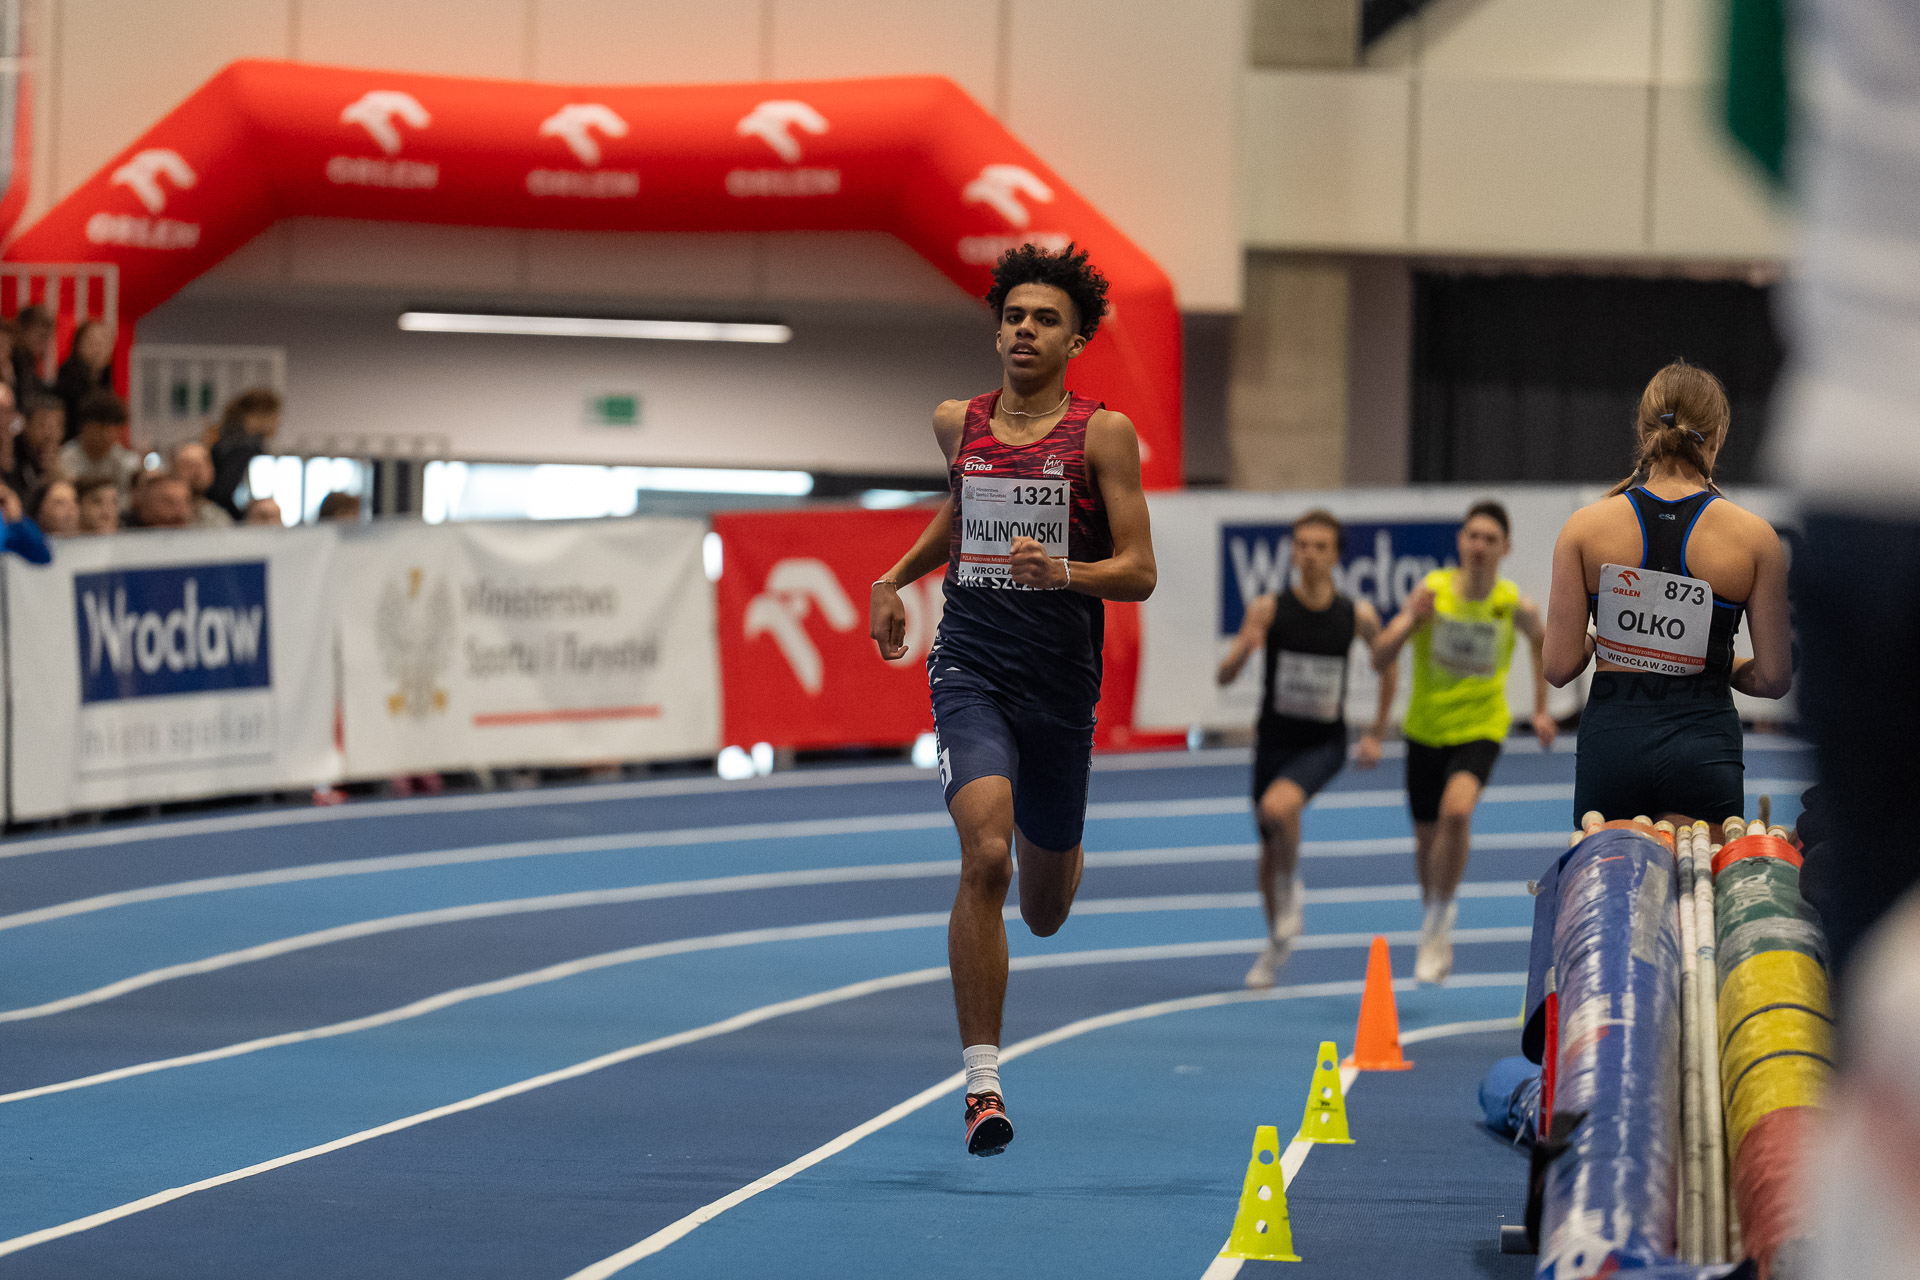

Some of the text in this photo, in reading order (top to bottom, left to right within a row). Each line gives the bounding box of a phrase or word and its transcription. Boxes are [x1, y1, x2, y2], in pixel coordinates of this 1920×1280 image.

[964, 461, 993, 471] Enea
[1012, 485, 1066, 506] 1321
[966, 519, 1062, 543] MALINOWSKI
[1612, 581, 1705, 606] ORLEN 873
[1617, 609, 1686, 640] OLKO
[1607, 651, 1687, 674] WROCŁAW 2025
